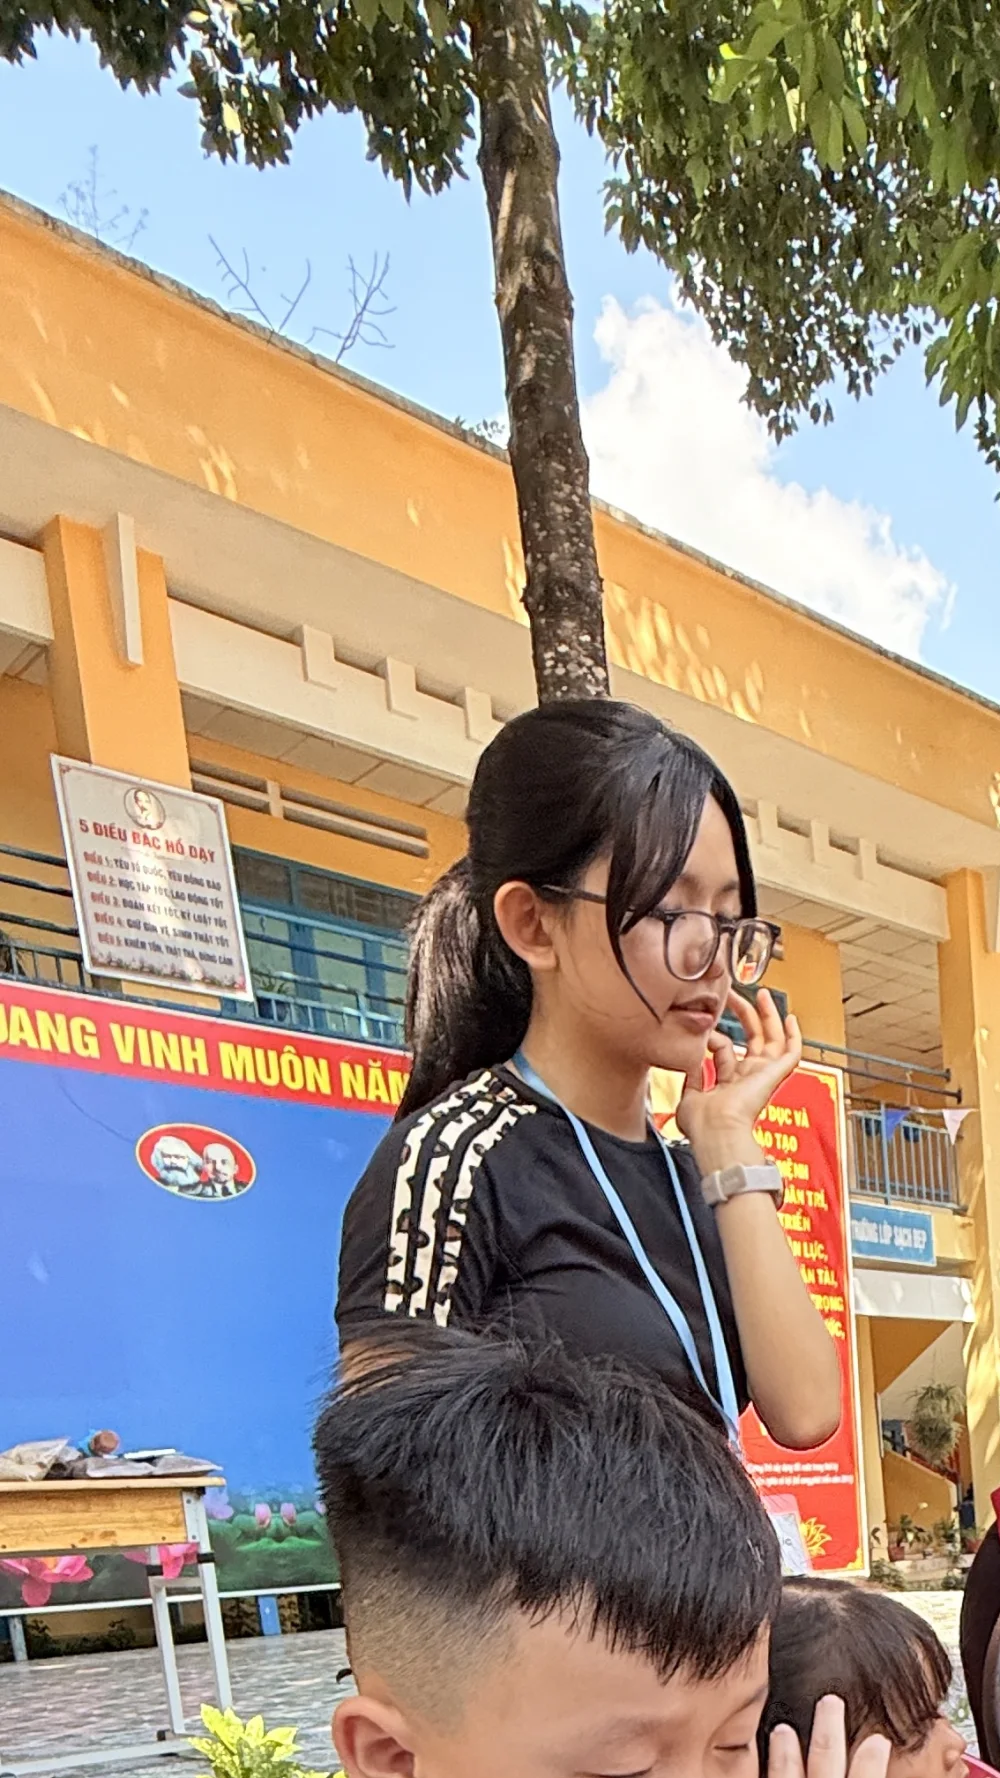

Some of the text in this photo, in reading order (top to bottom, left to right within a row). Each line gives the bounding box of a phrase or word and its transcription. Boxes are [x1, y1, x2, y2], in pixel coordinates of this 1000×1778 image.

[79, 818, 89, 833] 5
[93, 821, 127, 842] ĐIỀU
[188, 844, 216, 865] DẠY
[109, 1022, 209, 1076] VINH
[218, 1041, 332, 1096] MUÔN
[768, 1104, 793, 1127] DỤC
[793, 1107, 810, 1129] VÀ
[752, 1125, 798, 1154] ÀO TẠO
[776, 1208, 811, 1233] TRIỂN
[803, 1241, 828, 1263] LỰC,
[816, 1265, 838, 1288] TÀI,
